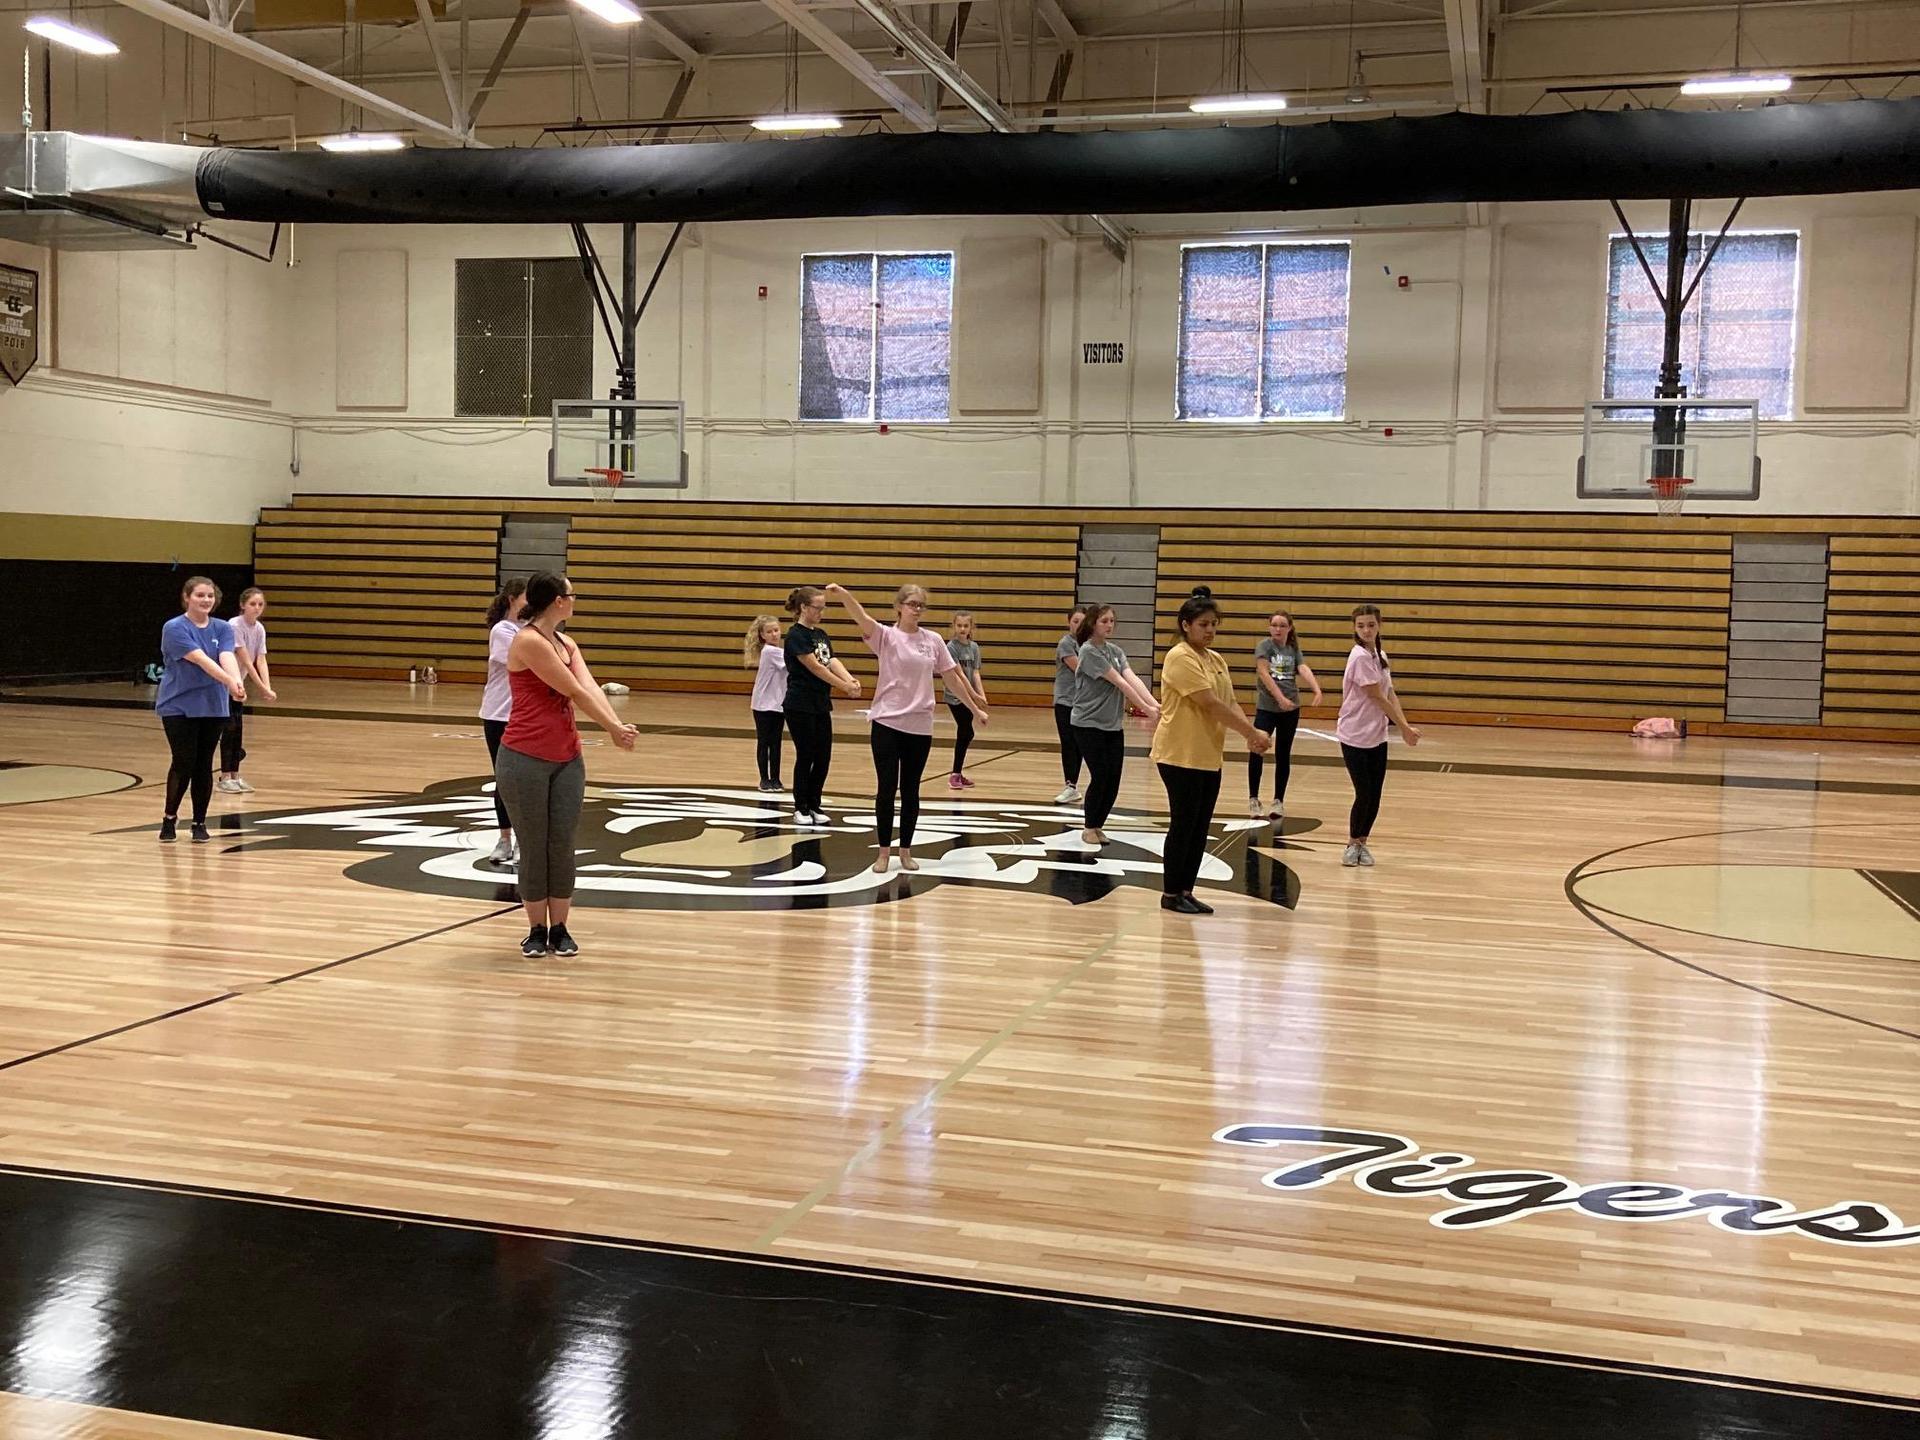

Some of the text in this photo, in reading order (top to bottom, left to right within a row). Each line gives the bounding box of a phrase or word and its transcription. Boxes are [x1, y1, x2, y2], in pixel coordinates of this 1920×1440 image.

[4, 336, 25, 349] 2018
[1083, 343, 1124, 364] VISITORS
[1213, 1123, 1920, 1247] Tigers
